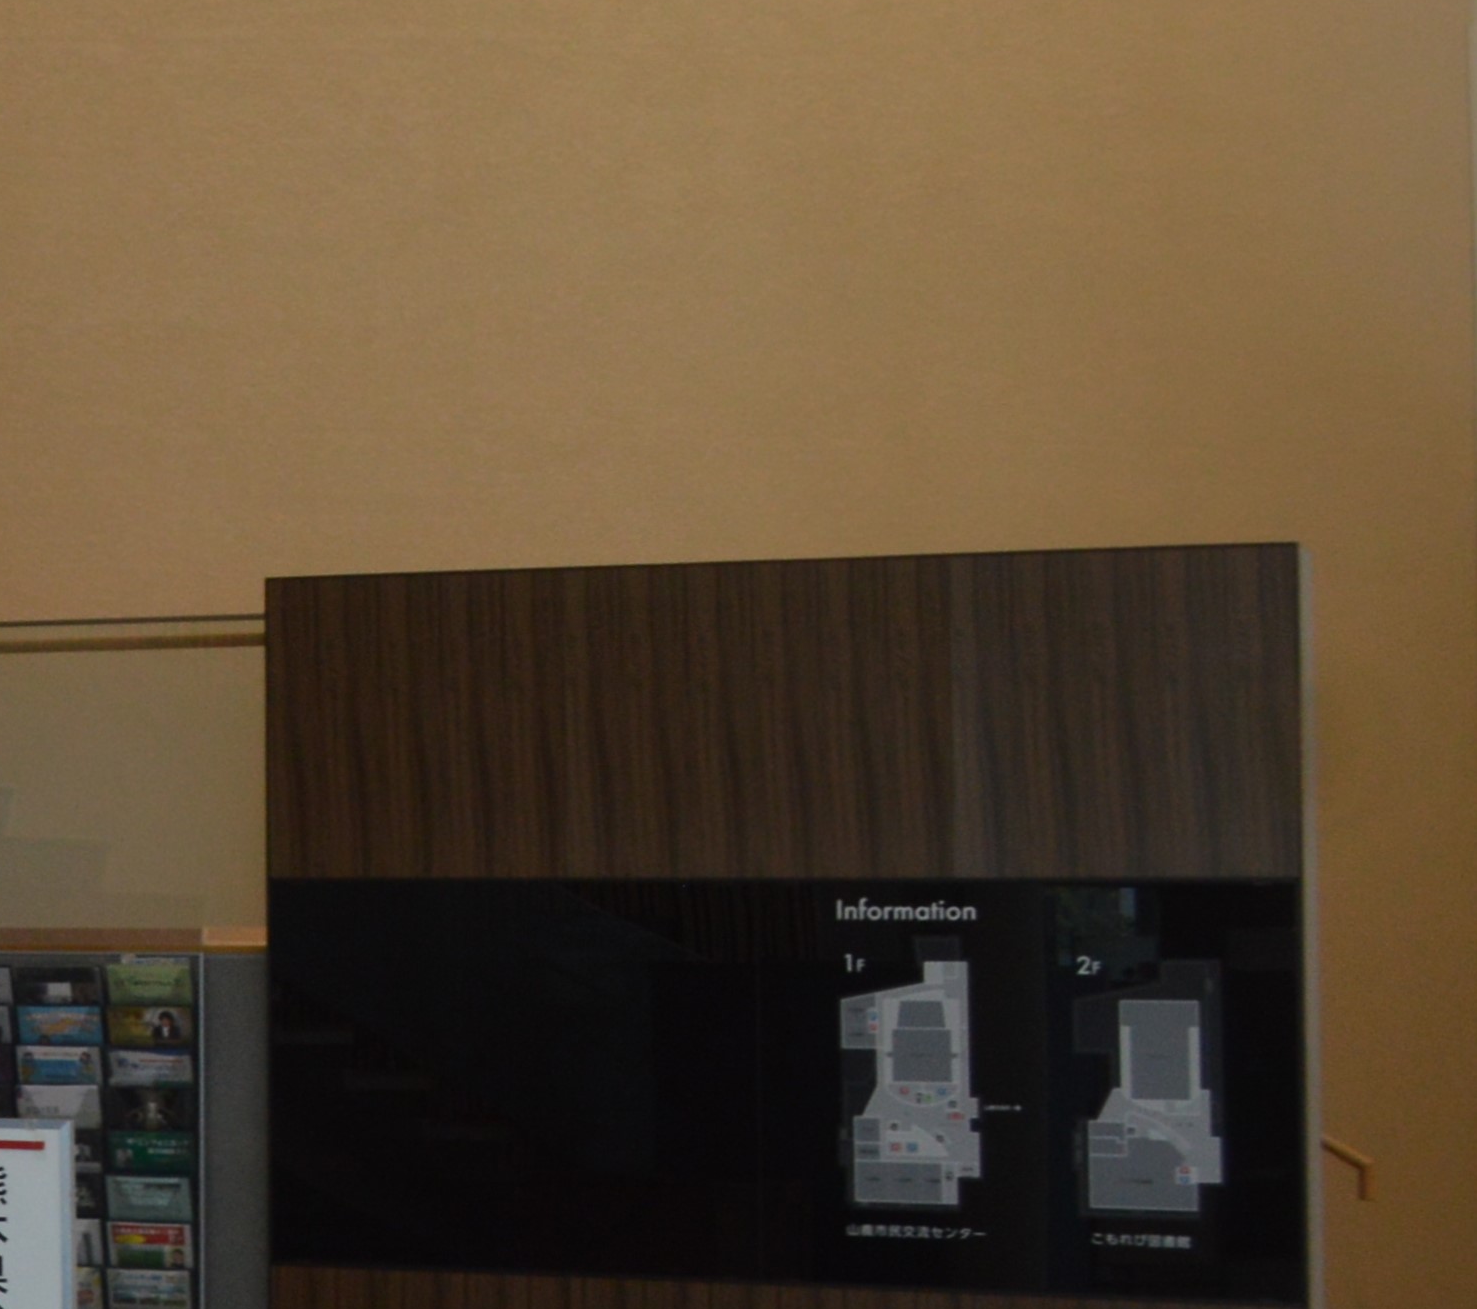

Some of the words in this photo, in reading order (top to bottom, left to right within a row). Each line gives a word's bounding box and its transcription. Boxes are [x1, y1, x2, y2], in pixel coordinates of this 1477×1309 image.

[836, 897, 977, 921] Information
[844, 953, 866, 972] 1F
[1076, 956, 1102, 975] 2F
